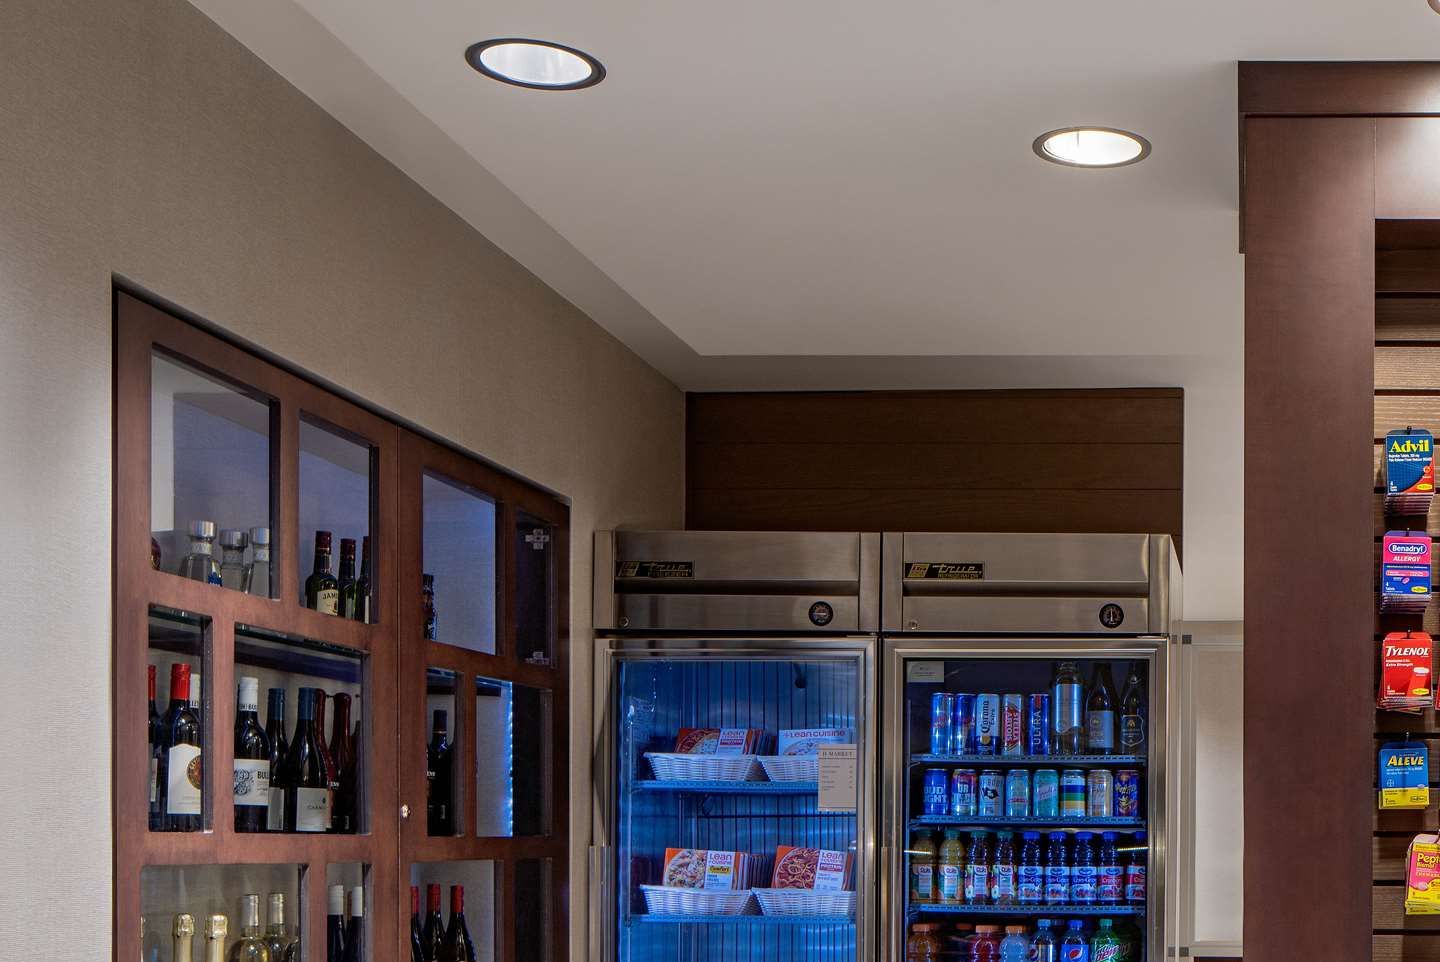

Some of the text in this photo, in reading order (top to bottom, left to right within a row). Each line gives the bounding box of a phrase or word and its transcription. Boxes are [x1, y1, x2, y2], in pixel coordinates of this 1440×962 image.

[1389, 440, 1429, 452] Advil
[1392, 544, 1423, 552] Benadryl
[1386, 646, 1429, 657] TYLENOL
[981, 700, 990, 734] Corona
[1033, 710, 1041, 745] ULTRA
[709, 853, 732, 861] Lean
[822, 852, 845, 860] Lean
